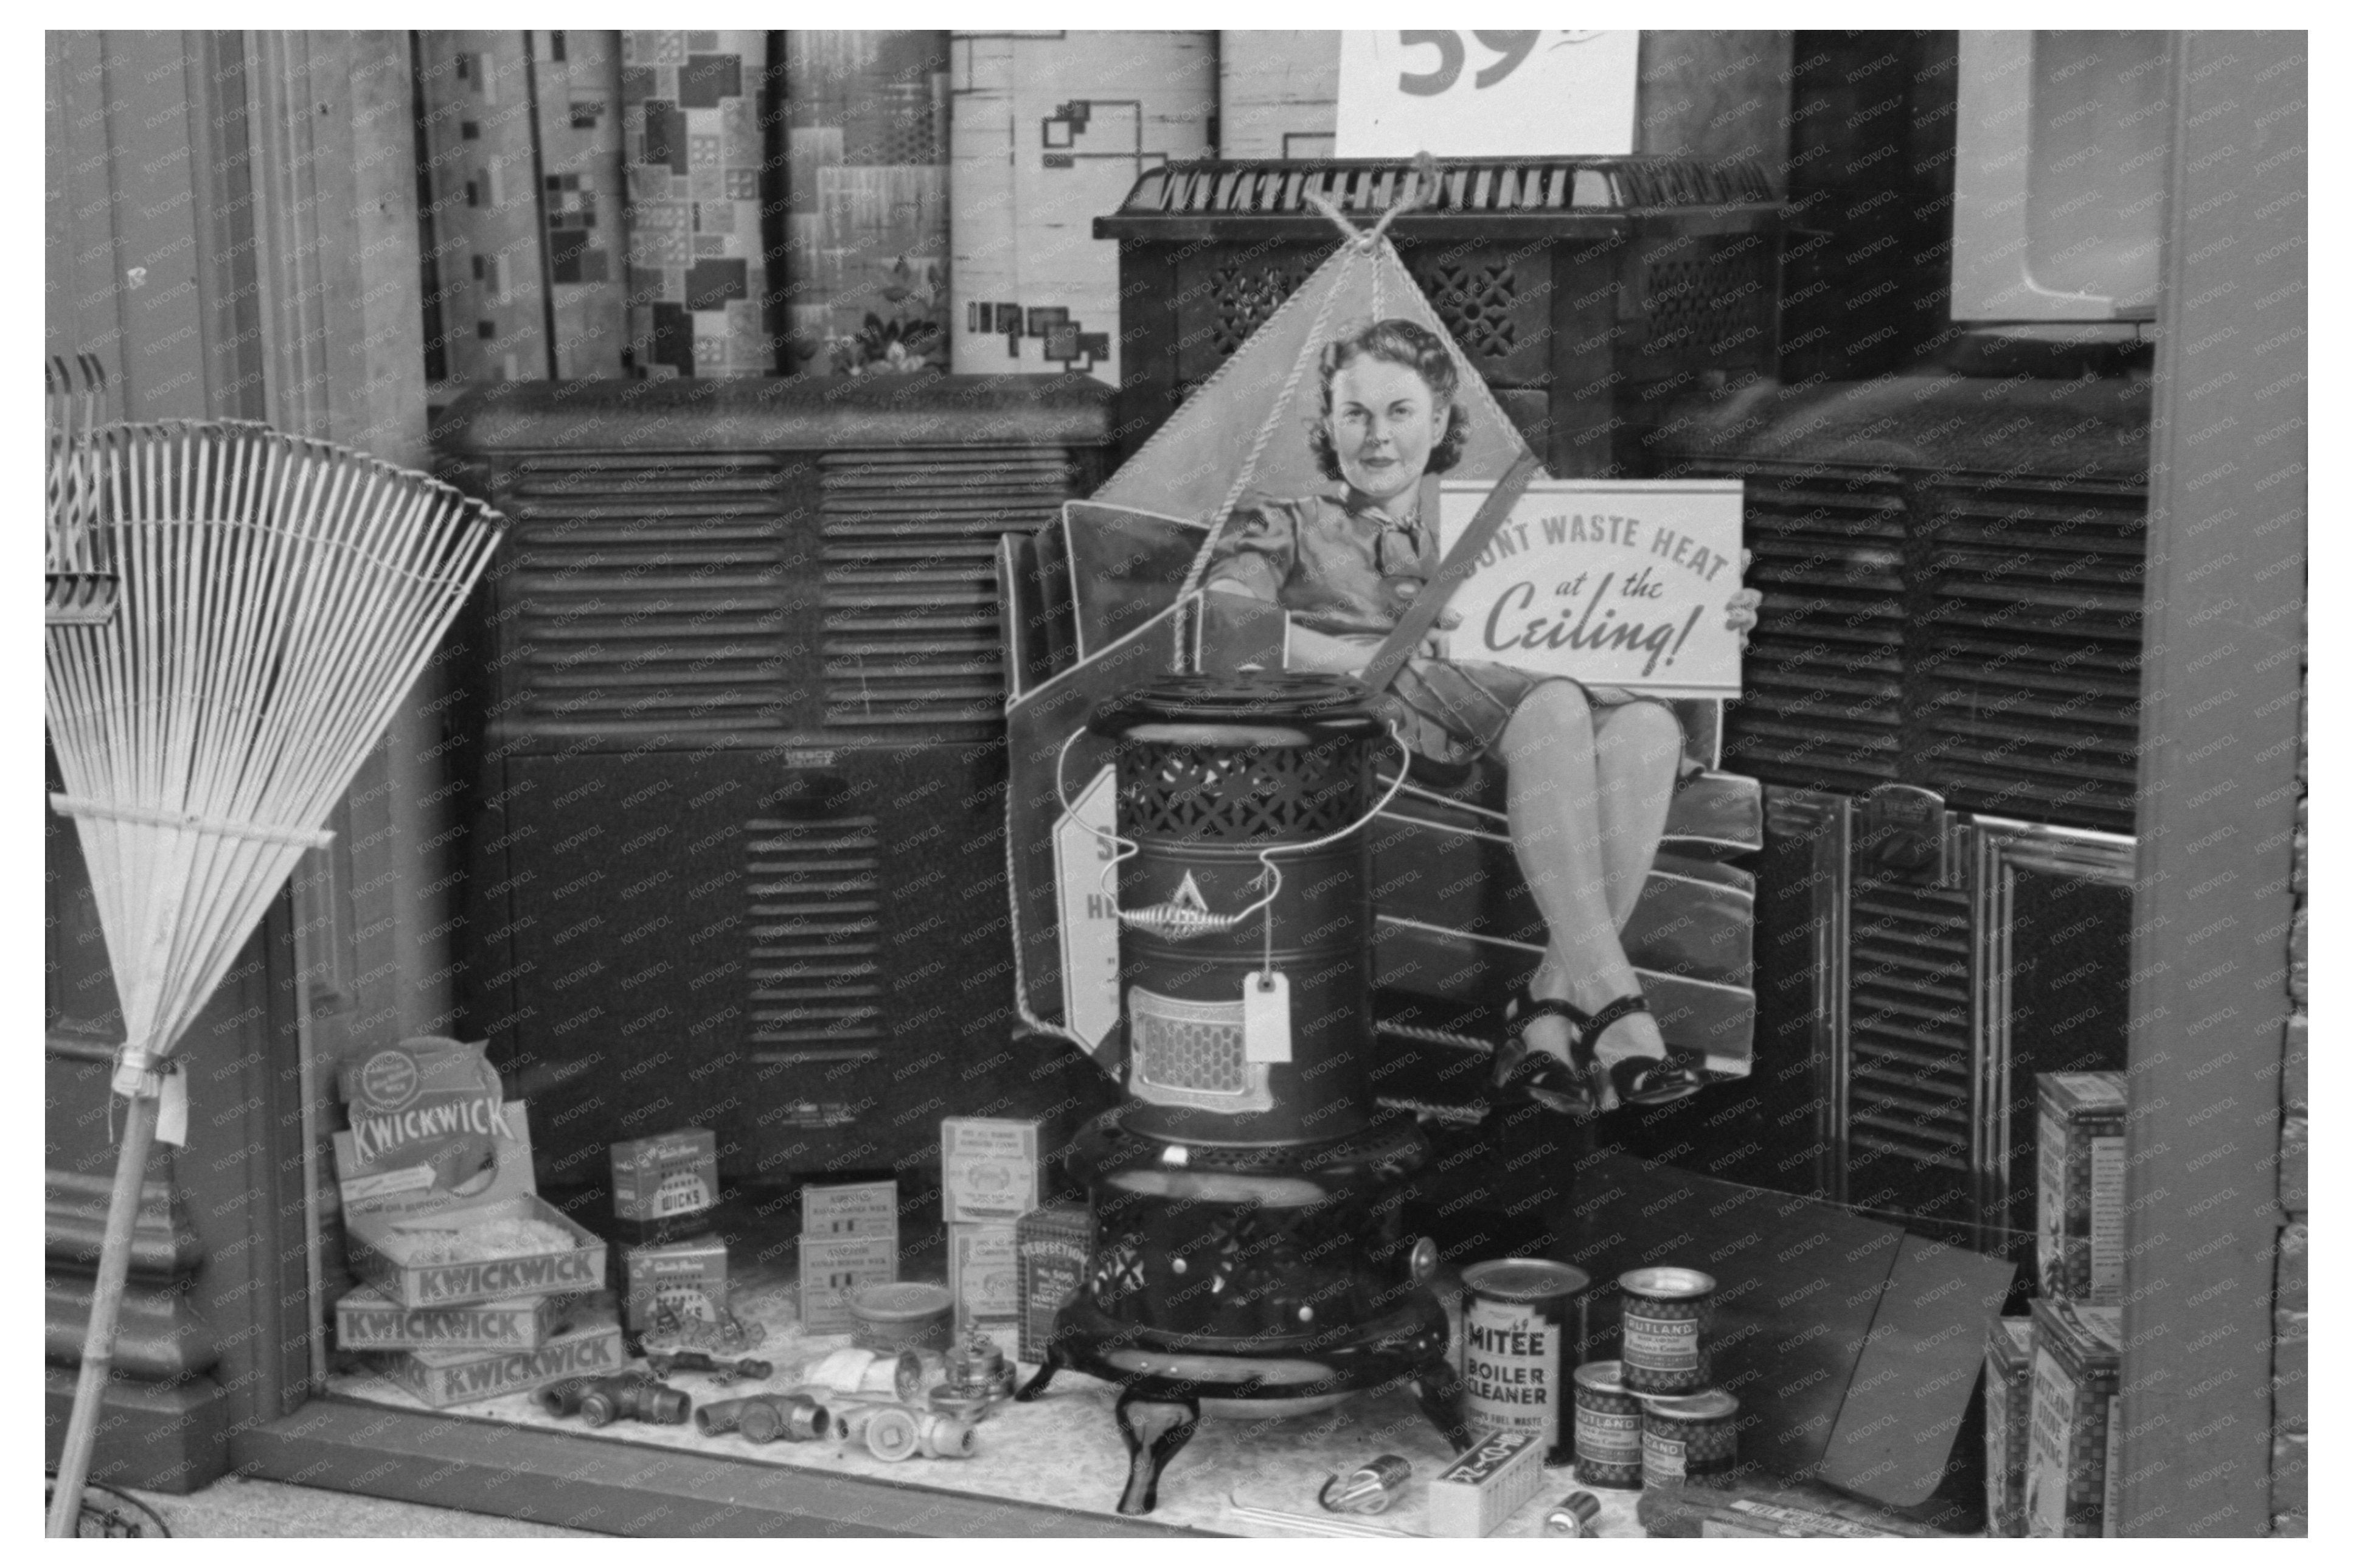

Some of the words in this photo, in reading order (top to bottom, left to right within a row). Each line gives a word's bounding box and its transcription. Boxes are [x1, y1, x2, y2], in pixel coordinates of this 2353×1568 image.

[1542, 515, 1640, 547] WASTE
[1652, 527, 1729, 582] HEAT
[1555, 571, 1587, 595] at
[1622, 567, 1663, 598] the
[1483, 572, 1705, 677] Ceiling!
[352, 1097, 516, 1165] KWICKWICK
[662, 1190, 700, 1210] WICKS
[1022, 1241, 1089, 1264] PERFECTION
[419, 1254, 595, 1299] KWICKWICK
[346, 1312, 522, 1341] KWICKWICK
[1469, 1322, 1545, 1355] MITEE
[1628, 1319, 1692, 1334] RUTLAND
[444, 1337, 611, 1396] KWICKWICK
[1469, 1358, 1544, 1385] BOILER
[1468, 1377, 1547, 1405] CLEANER
[1514, 1417, 1543, 1427] WASTE
[1648, 1438, 1678, 1455] LAND
